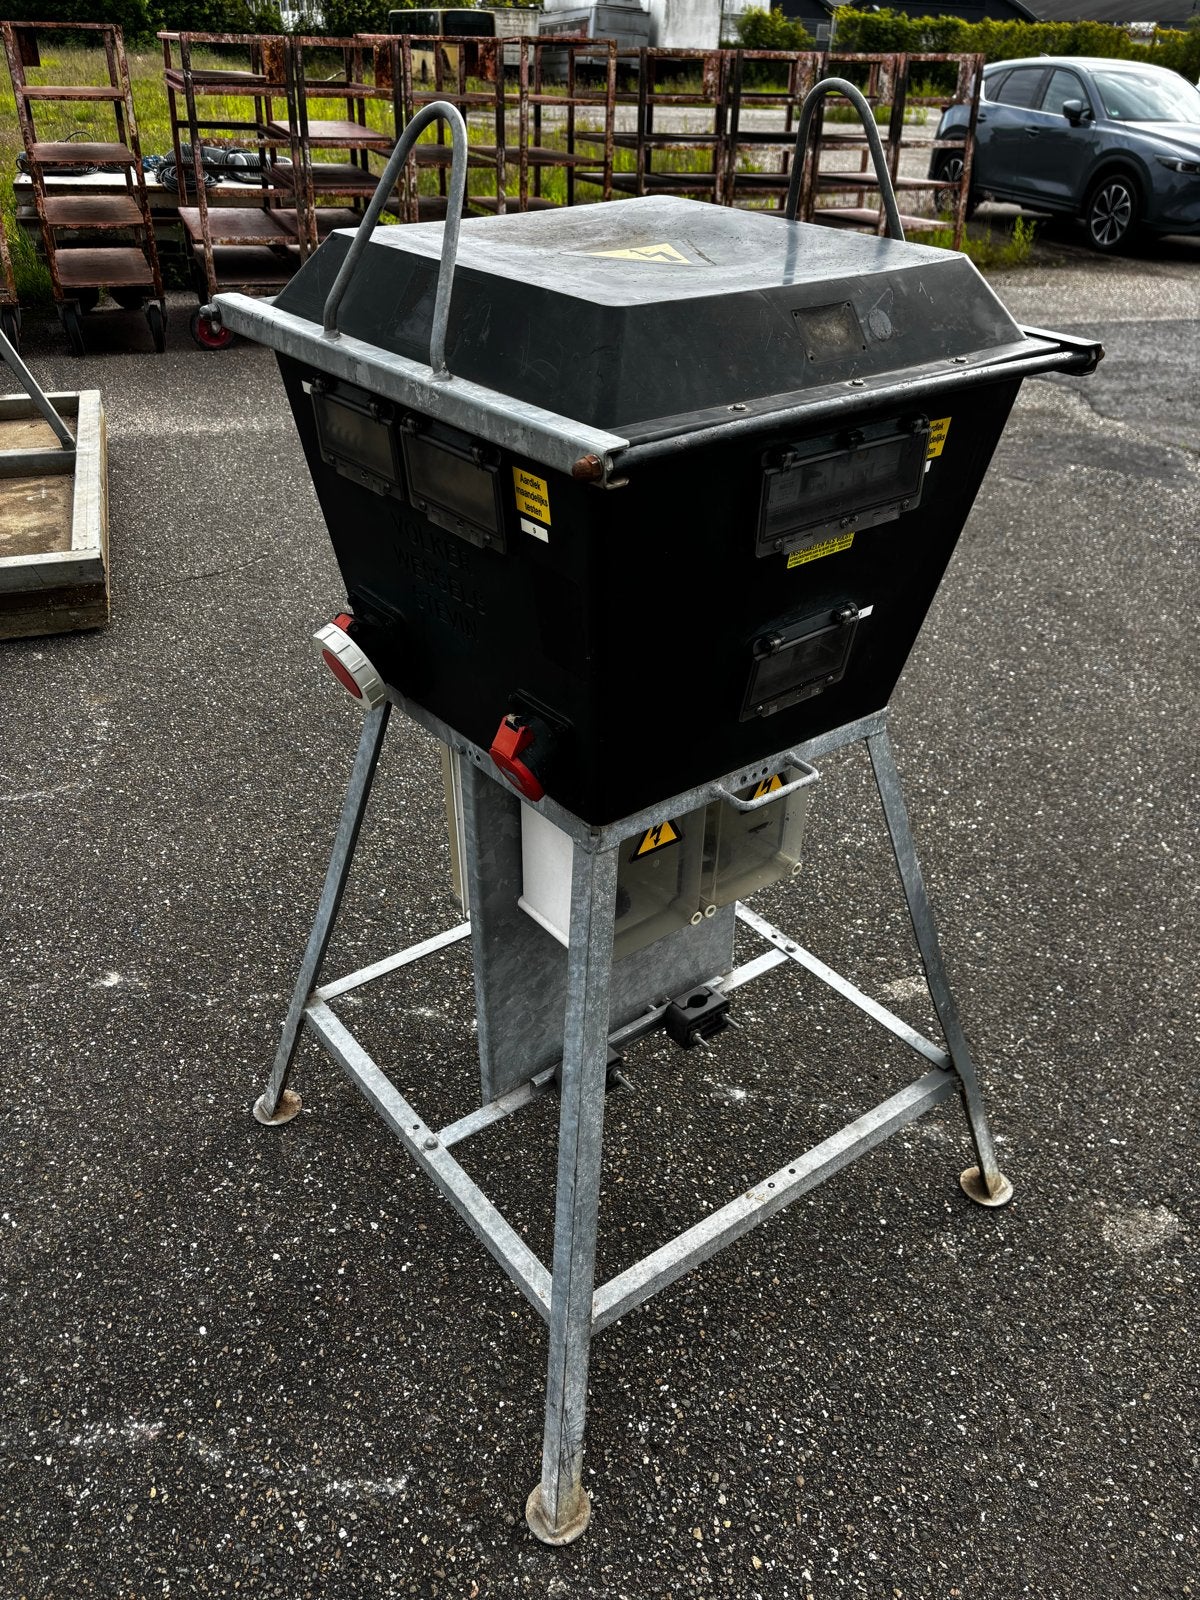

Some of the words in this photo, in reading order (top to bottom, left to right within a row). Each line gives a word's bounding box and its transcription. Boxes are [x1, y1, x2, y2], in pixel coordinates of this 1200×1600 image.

[520, 473, 541, 491] Aardlek
[516, 486, 549, 507] maandelijks
[524, 501, 543, 517] testen
[391, 510, 471, 573] VOLKER
